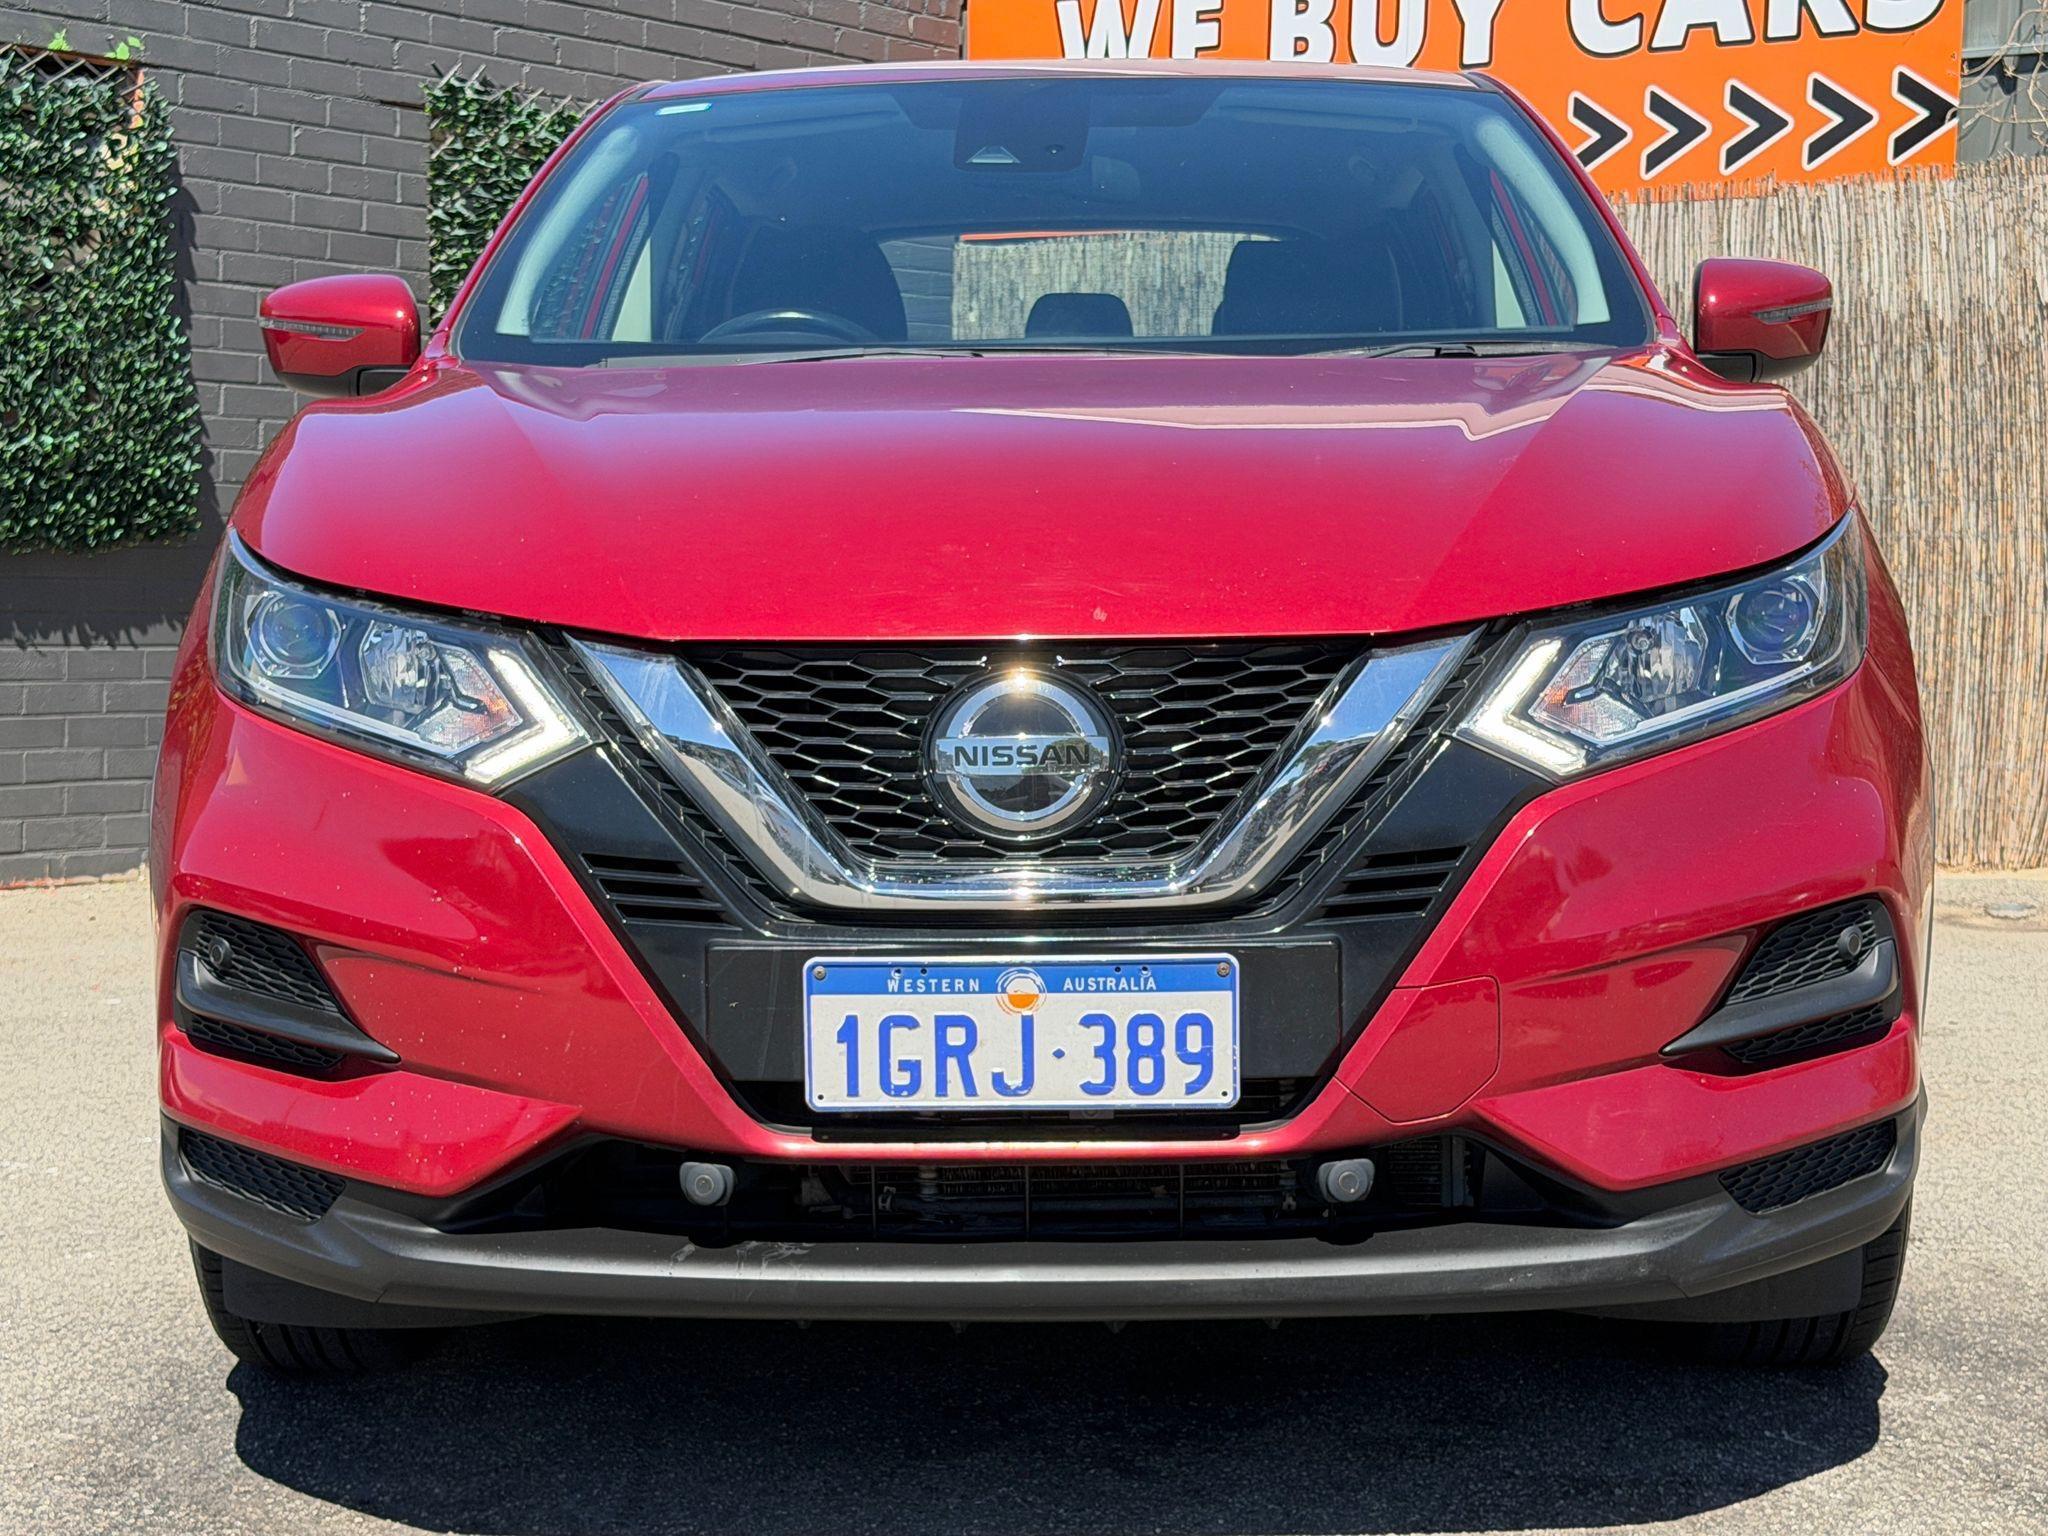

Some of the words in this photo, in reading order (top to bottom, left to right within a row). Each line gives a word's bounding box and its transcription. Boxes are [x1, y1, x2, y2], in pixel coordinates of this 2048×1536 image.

[1055, 0, 1223, 59] WE
[1267, 0, 1502, 69] BUY
[954, 745, 1090, 767] NISSAN
[887, 978, 980, 993] WESTERN
[1063, 977, 1157, 991] AUSTRALIA
